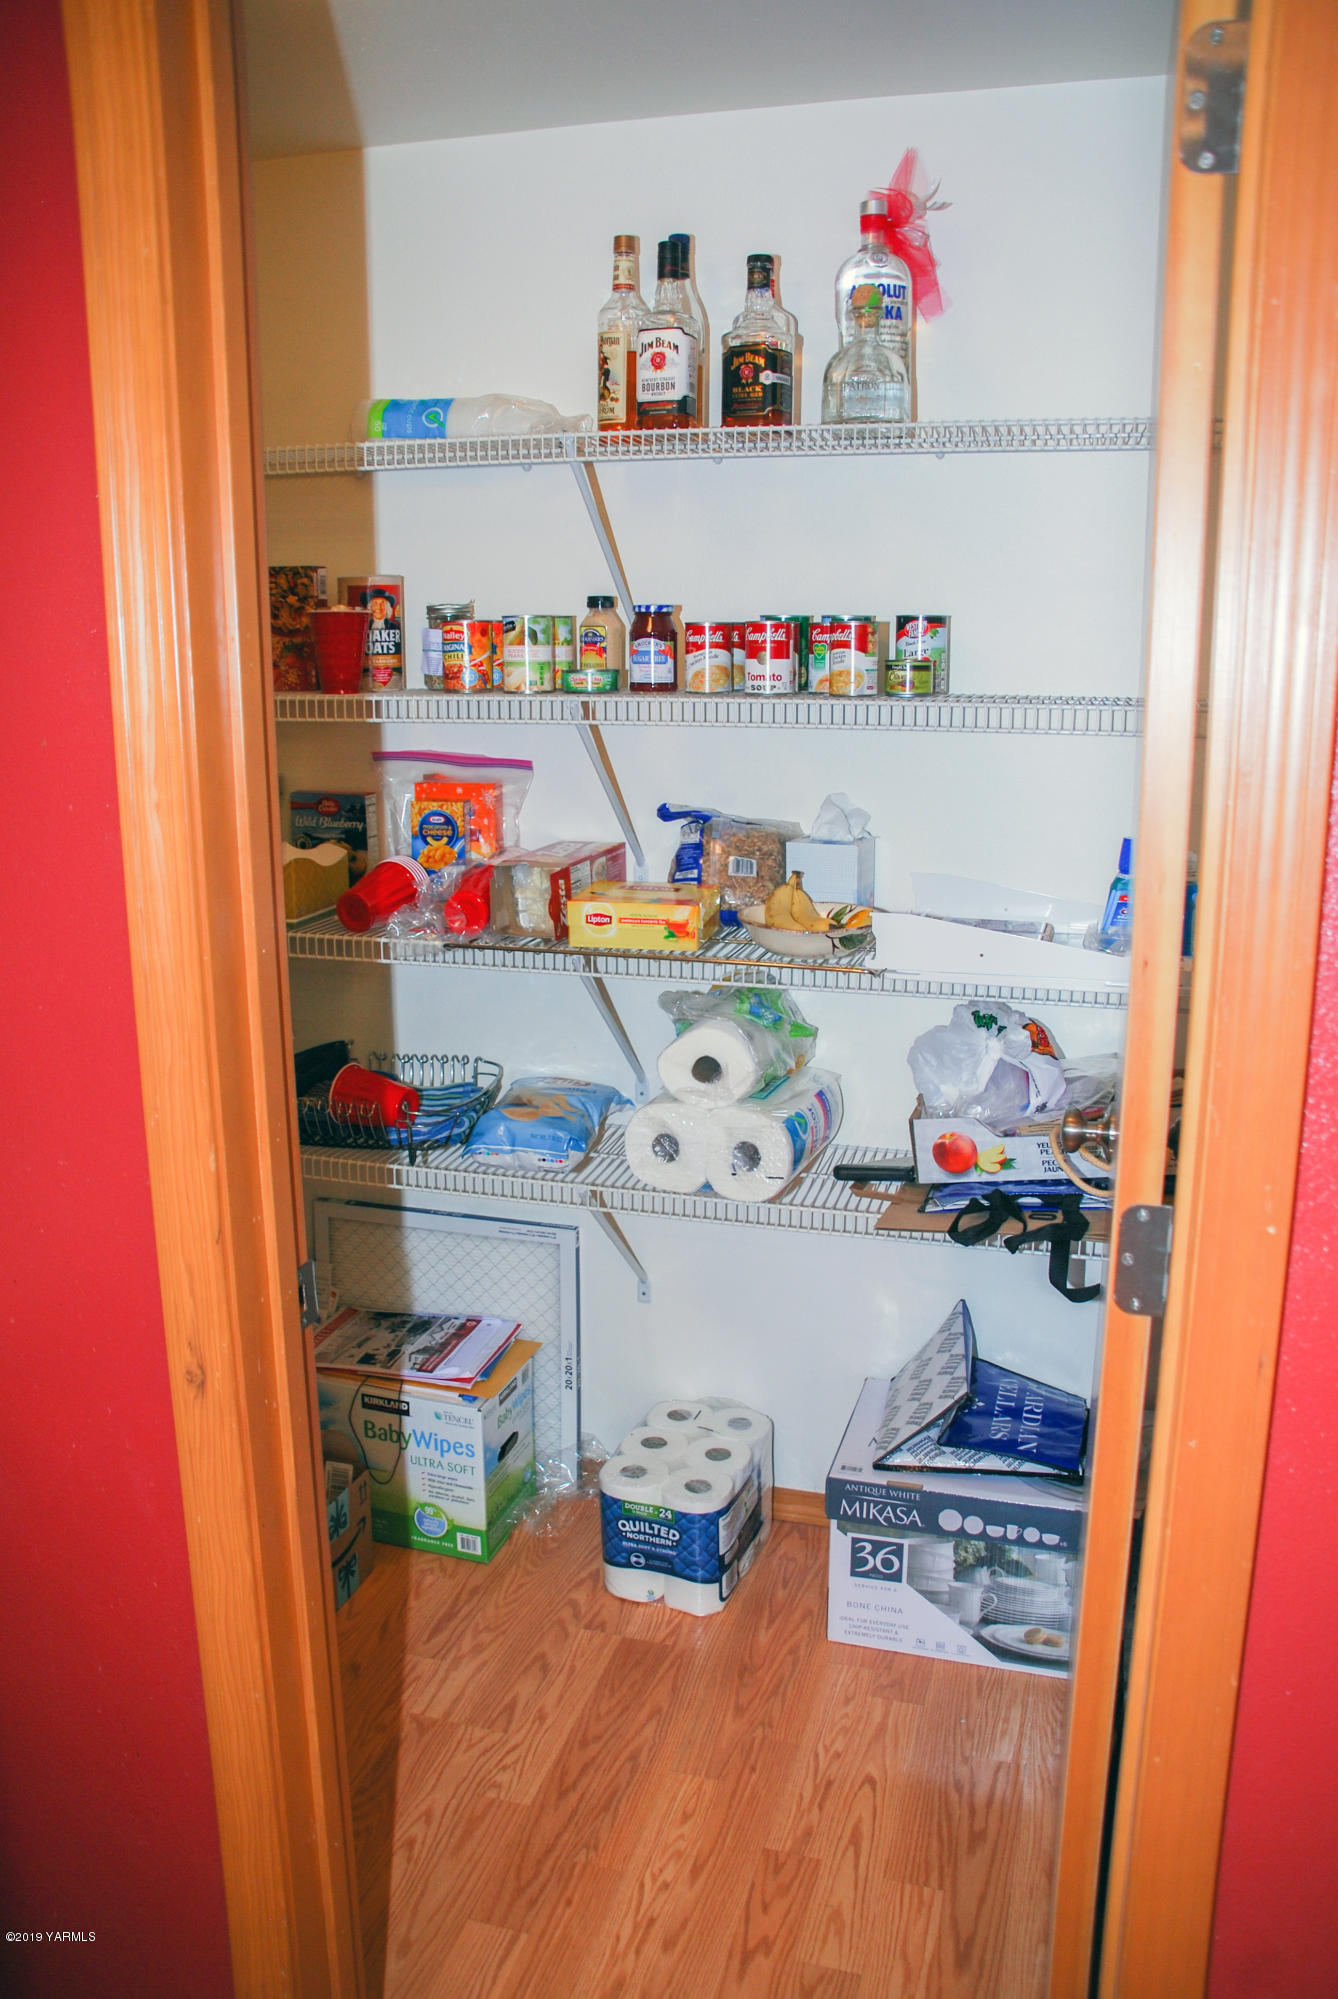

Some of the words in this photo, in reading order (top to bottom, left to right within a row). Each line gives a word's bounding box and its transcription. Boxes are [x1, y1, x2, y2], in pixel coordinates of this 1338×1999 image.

[849, 283, 907, 300] AOLUT
[640, 341, 654, 357] JIM
[655, 337, 679, 355] BEAM
[731, 356, 745, 370] JIM
[745, 352, 766, 368] BEAM
[641, 382, 676, 393] BOURBON
[366, 642, 396, 654] OATS
[296, 815, 317, 827] Wild
[319, 816, 364, 832] Blueberry
[588, 915, 611, 923] Lipton
[363, 1397, 409, 1411] KIRKLAND
[989, 1379, 1019, 1440] CELLARS
[410, 1455, 444, 1471] ULTRA
[447, 1461, 477, 1476] SOFT
[844, 1483, 887, 1496] ANTIQUE
[889, 1489, 921, 1501] WHITE
[625, 1502, 655, 1513] DOUBLE
[659, 1508, 674, 1520] 24
[840, 1498, 923, 1527] MIKASA
[618, 1519, 681, 1542] QUILTED
[626, 1532, 673, 1547] NORTHERN
[854, 1541, 901, 1574] 36
[846, 1601, 873, 1610] BONE
[874, 1604, 904, 1615] CHINA
